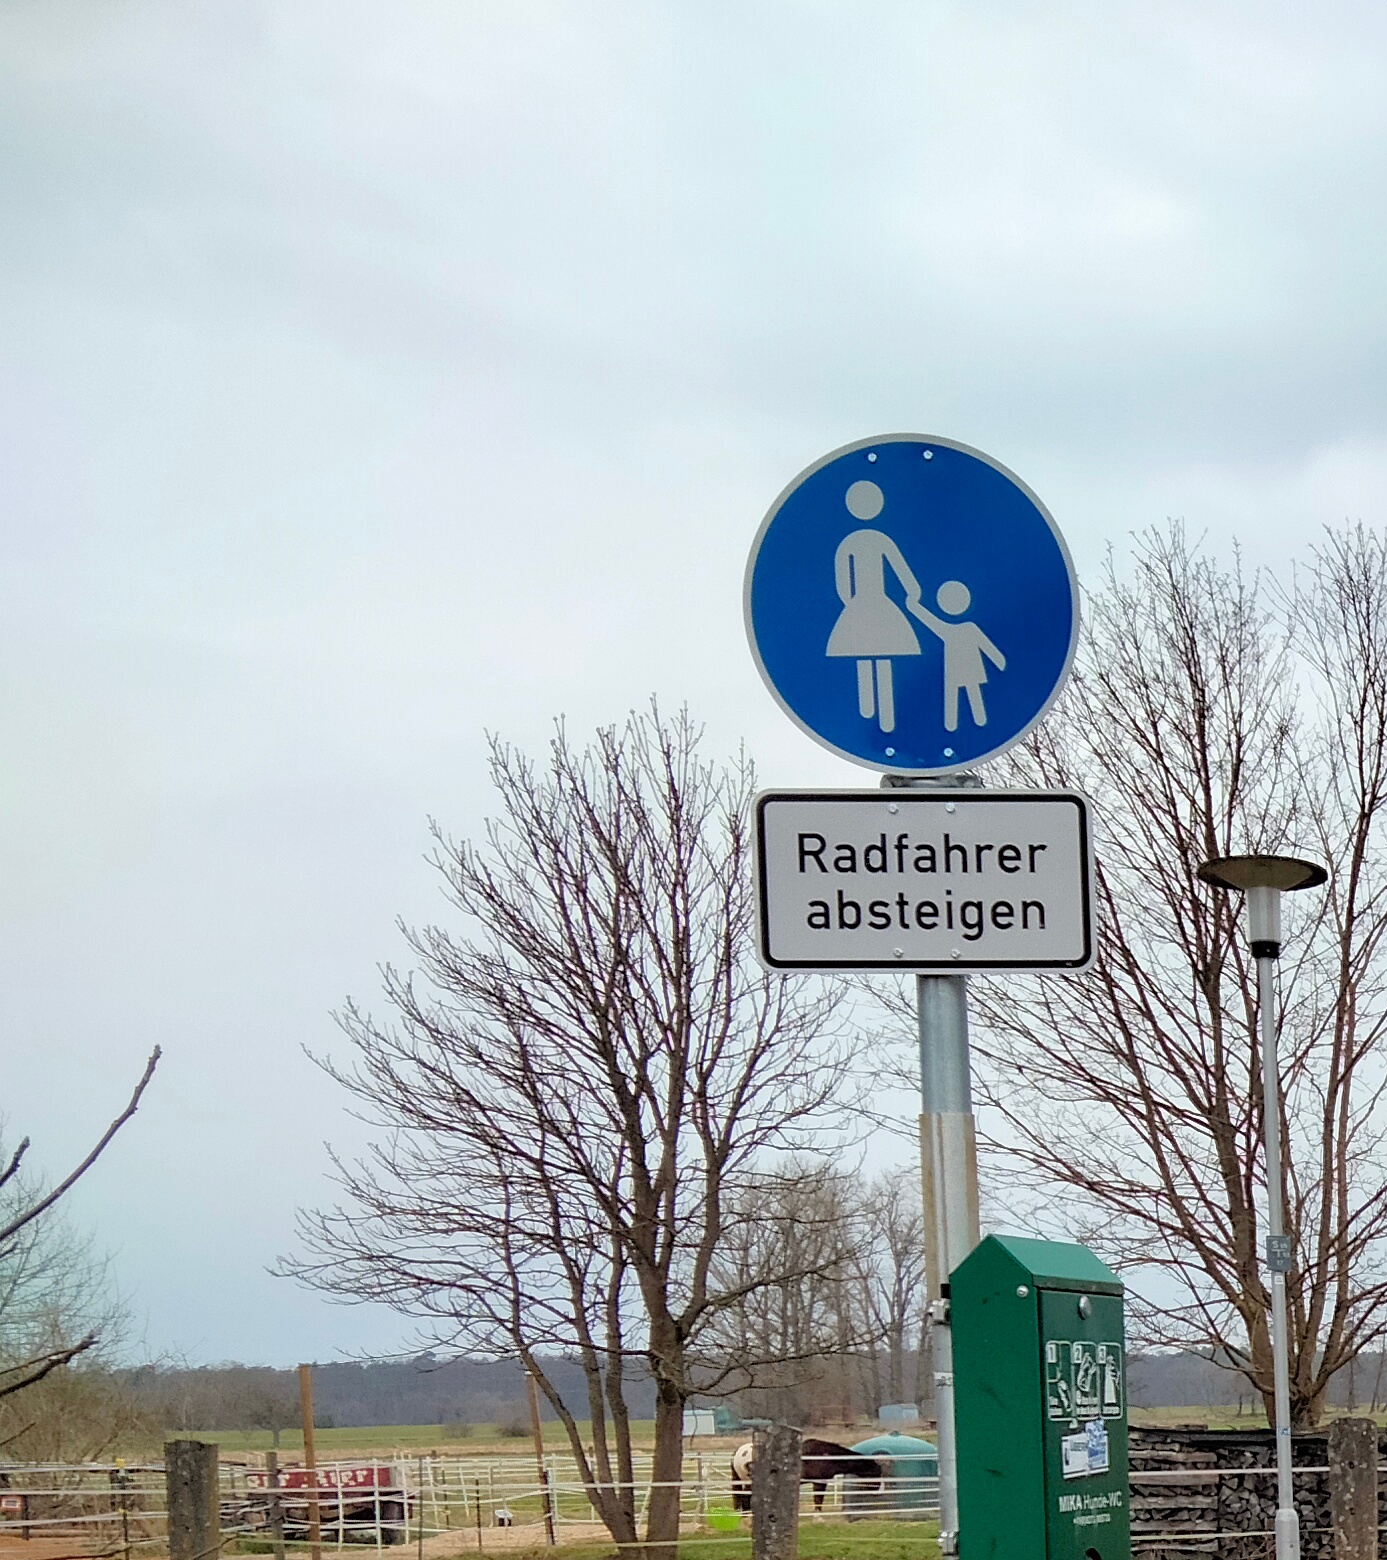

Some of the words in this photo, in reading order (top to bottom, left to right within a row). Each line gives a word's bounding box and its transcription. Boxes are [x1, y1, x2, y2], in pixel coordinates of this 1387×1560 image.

[797, 832, 1047, 874] Radfahrer
[806, 889, 1046, 941] absteigen
[1075, 1346, 1081, 1361] 2
